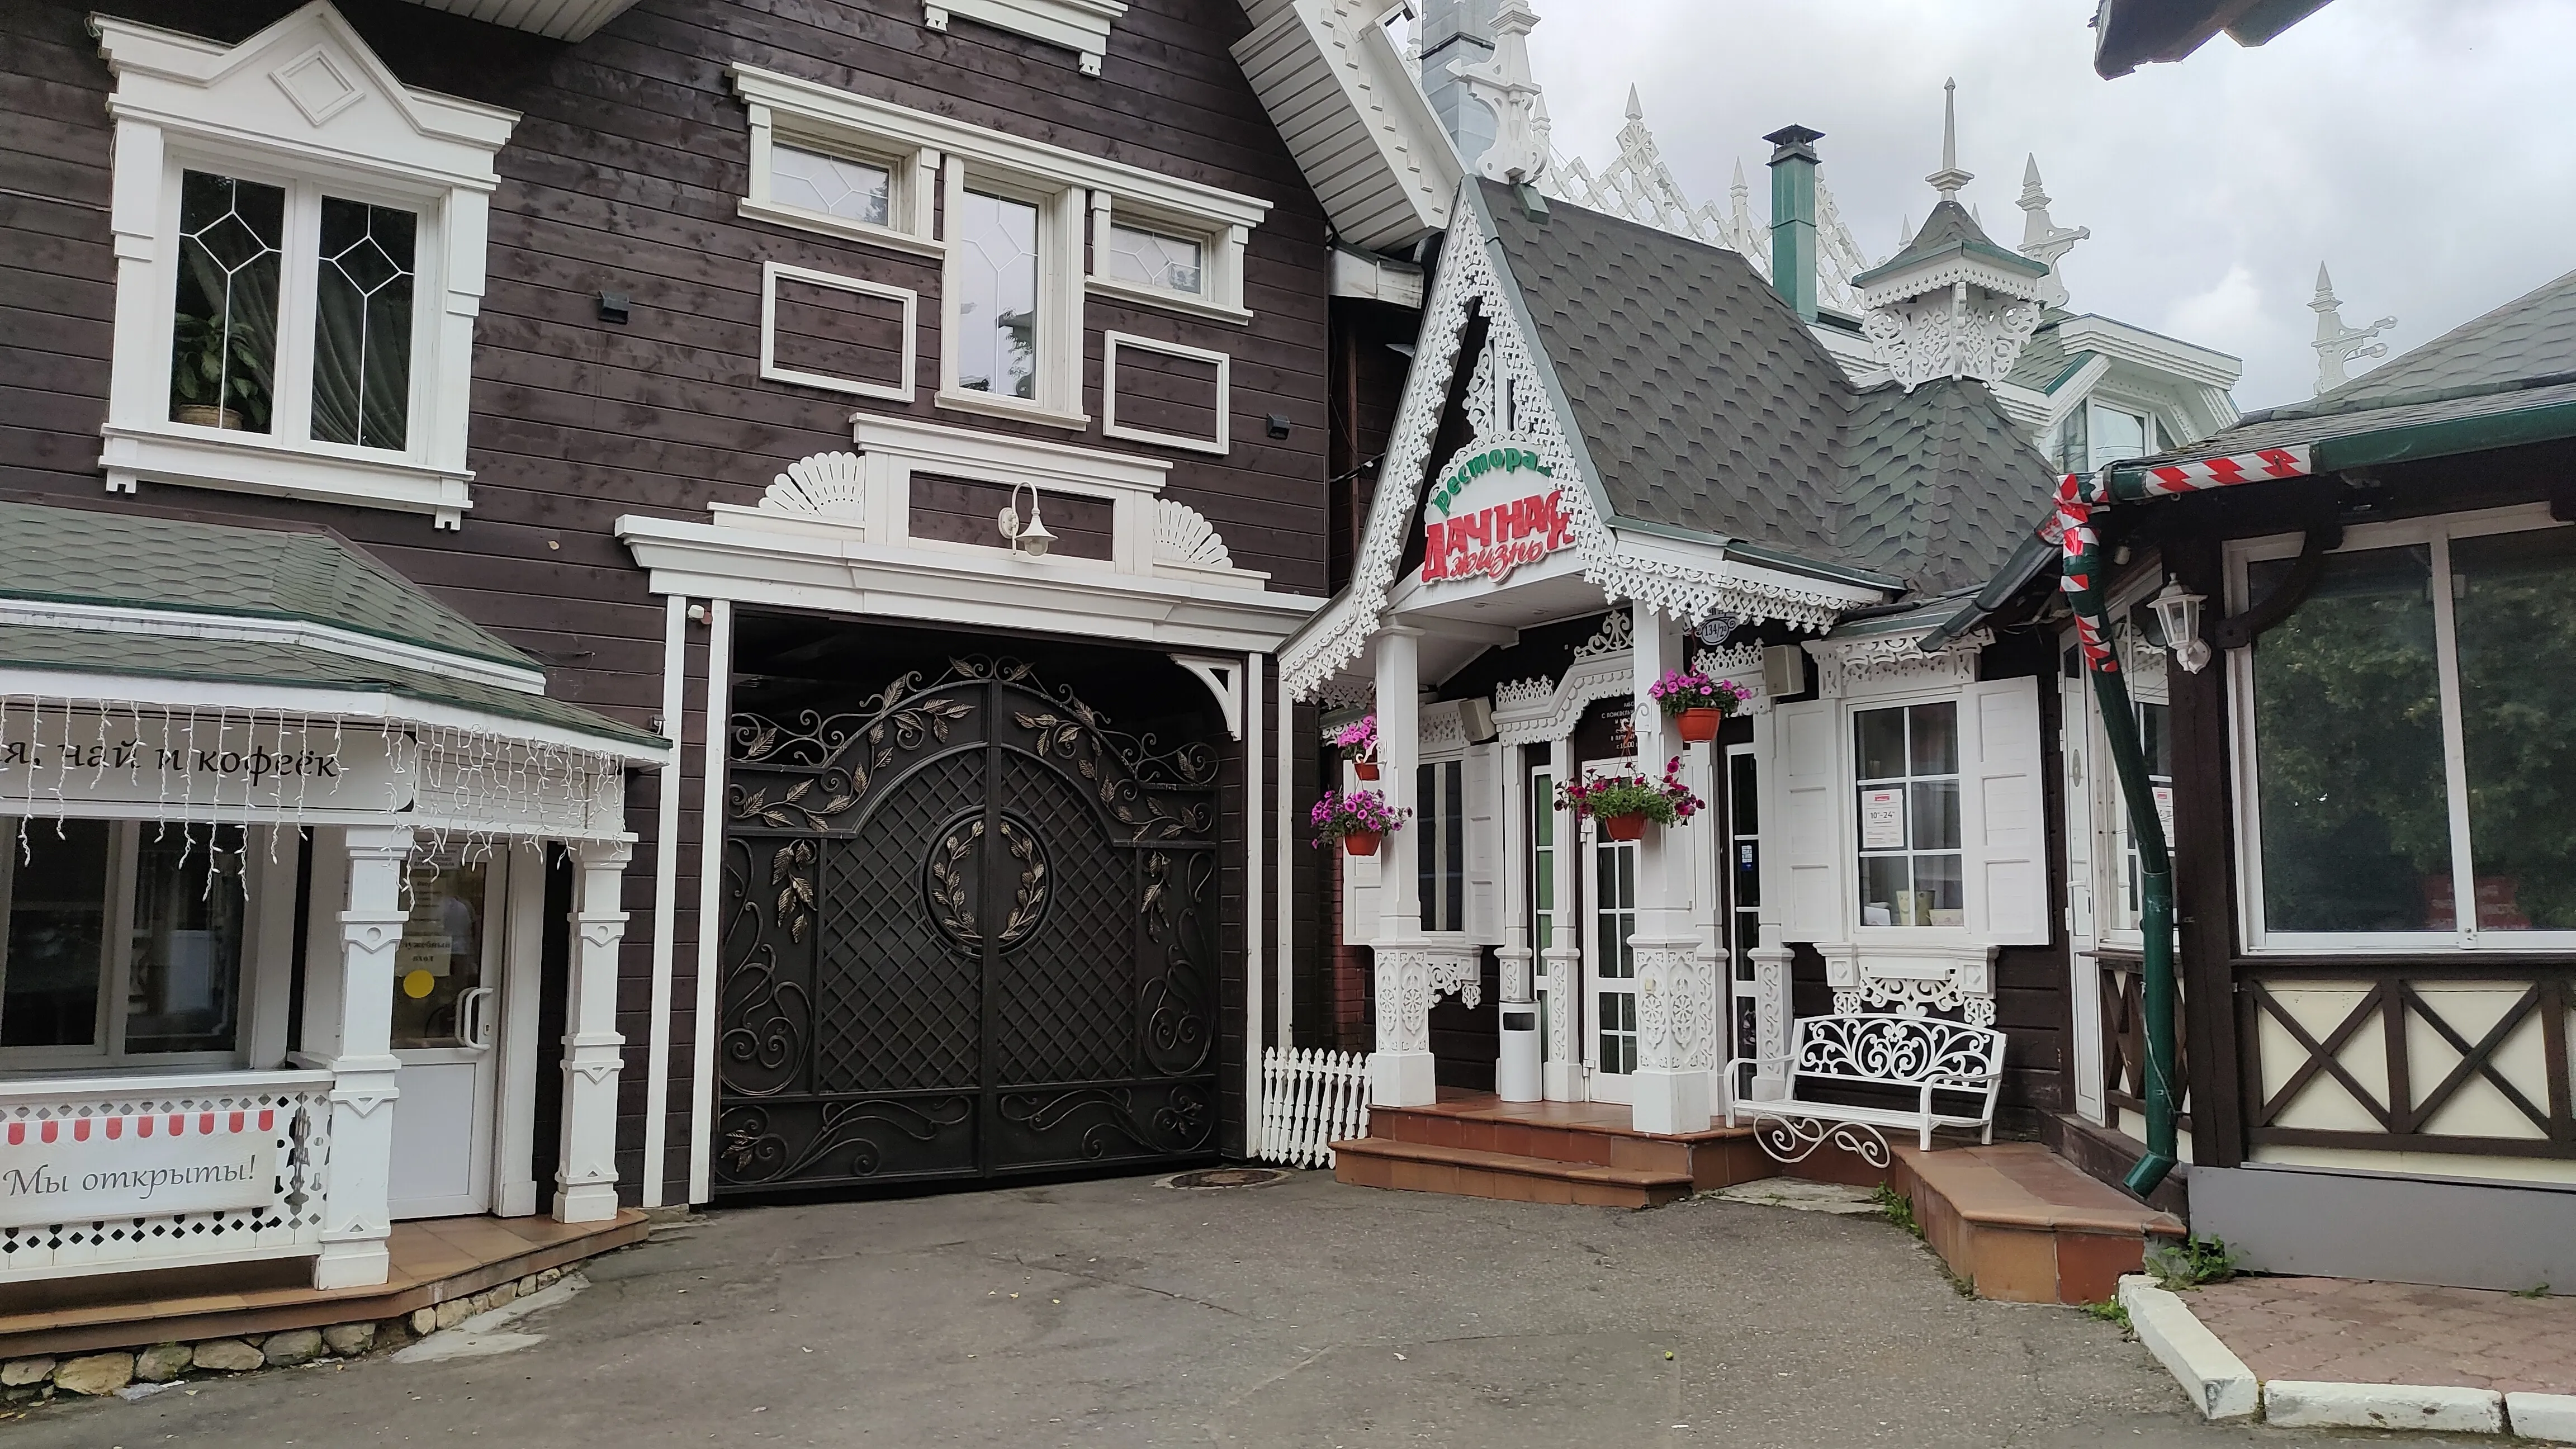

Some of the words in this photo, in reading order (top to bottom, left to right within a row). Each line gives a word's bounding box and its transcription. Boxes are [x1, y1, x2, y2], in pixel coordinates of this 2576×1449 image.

[1422, 489, 1575, 582] ДАЧНАЯ
[1450, 539, 1542, 578] жизнь
[1607, 709, 1635, 718] ПОНЕДЕЛЬН
[0, 741, 40, 771] я,
[57, 738, 141, 768] чай
[155, 748, 183, 771] и
[198, 745, 337, 787] кофеёк
[3, 1164, 69, 1196] Мы
[82, 1154, 256, 1200] открыты!
